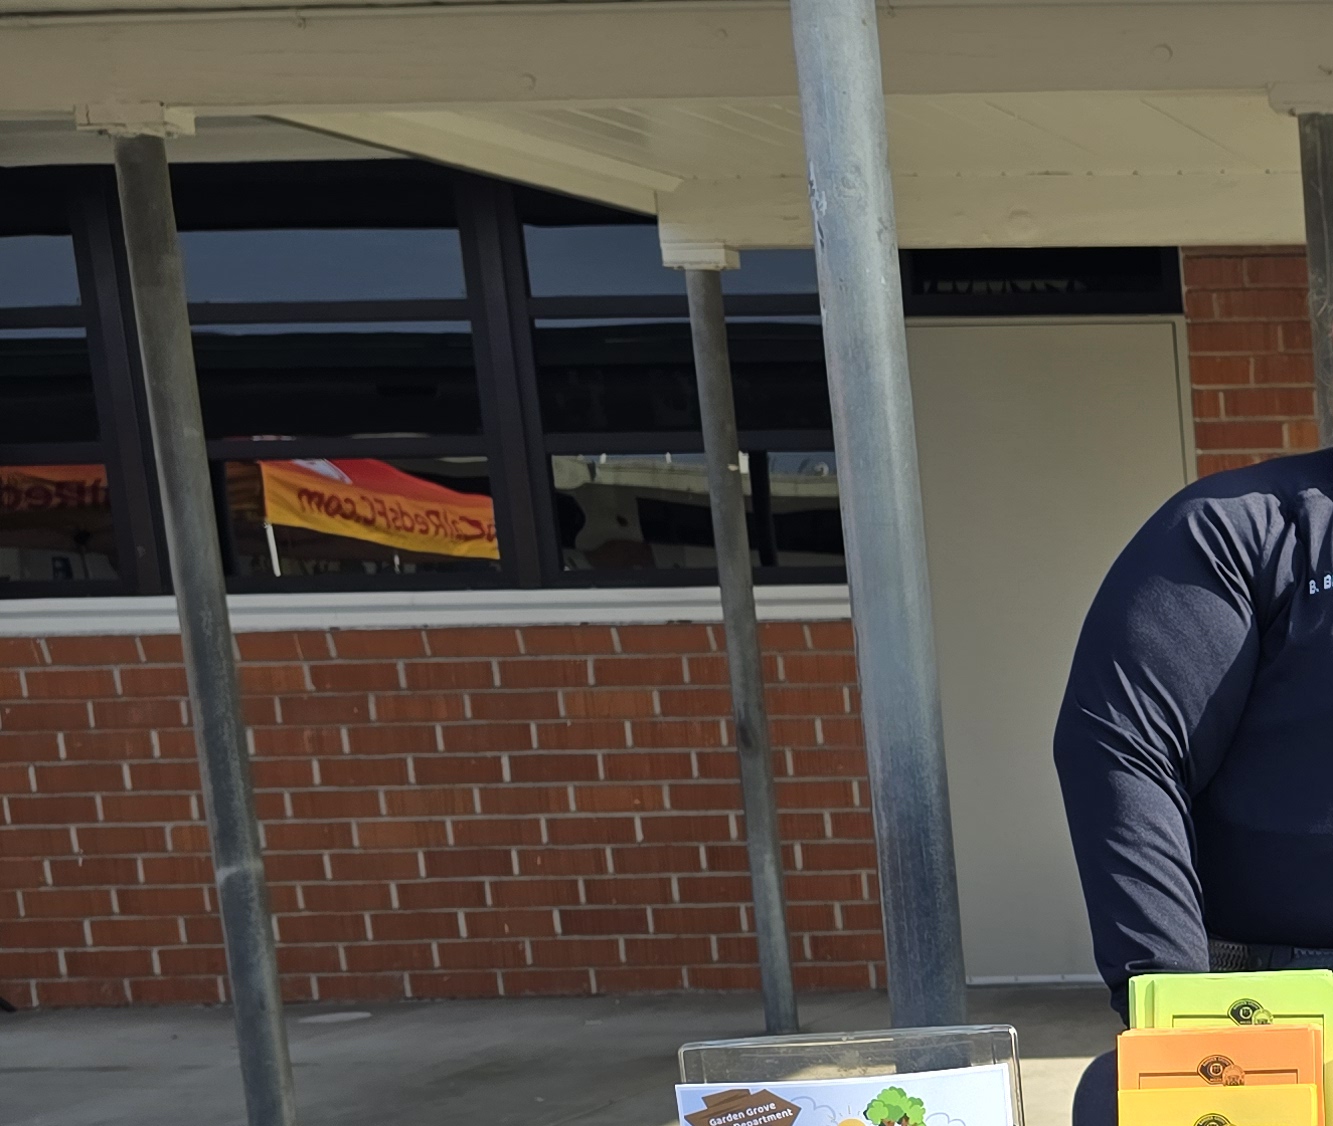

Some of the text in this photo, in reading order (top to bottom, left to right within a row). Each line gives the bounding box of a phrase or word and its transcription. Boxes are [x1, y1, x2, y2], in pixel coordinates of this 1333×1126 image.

[1309, 579, 1319, 594] B.
[709, 1102, 776, 1126] Garden Grove
